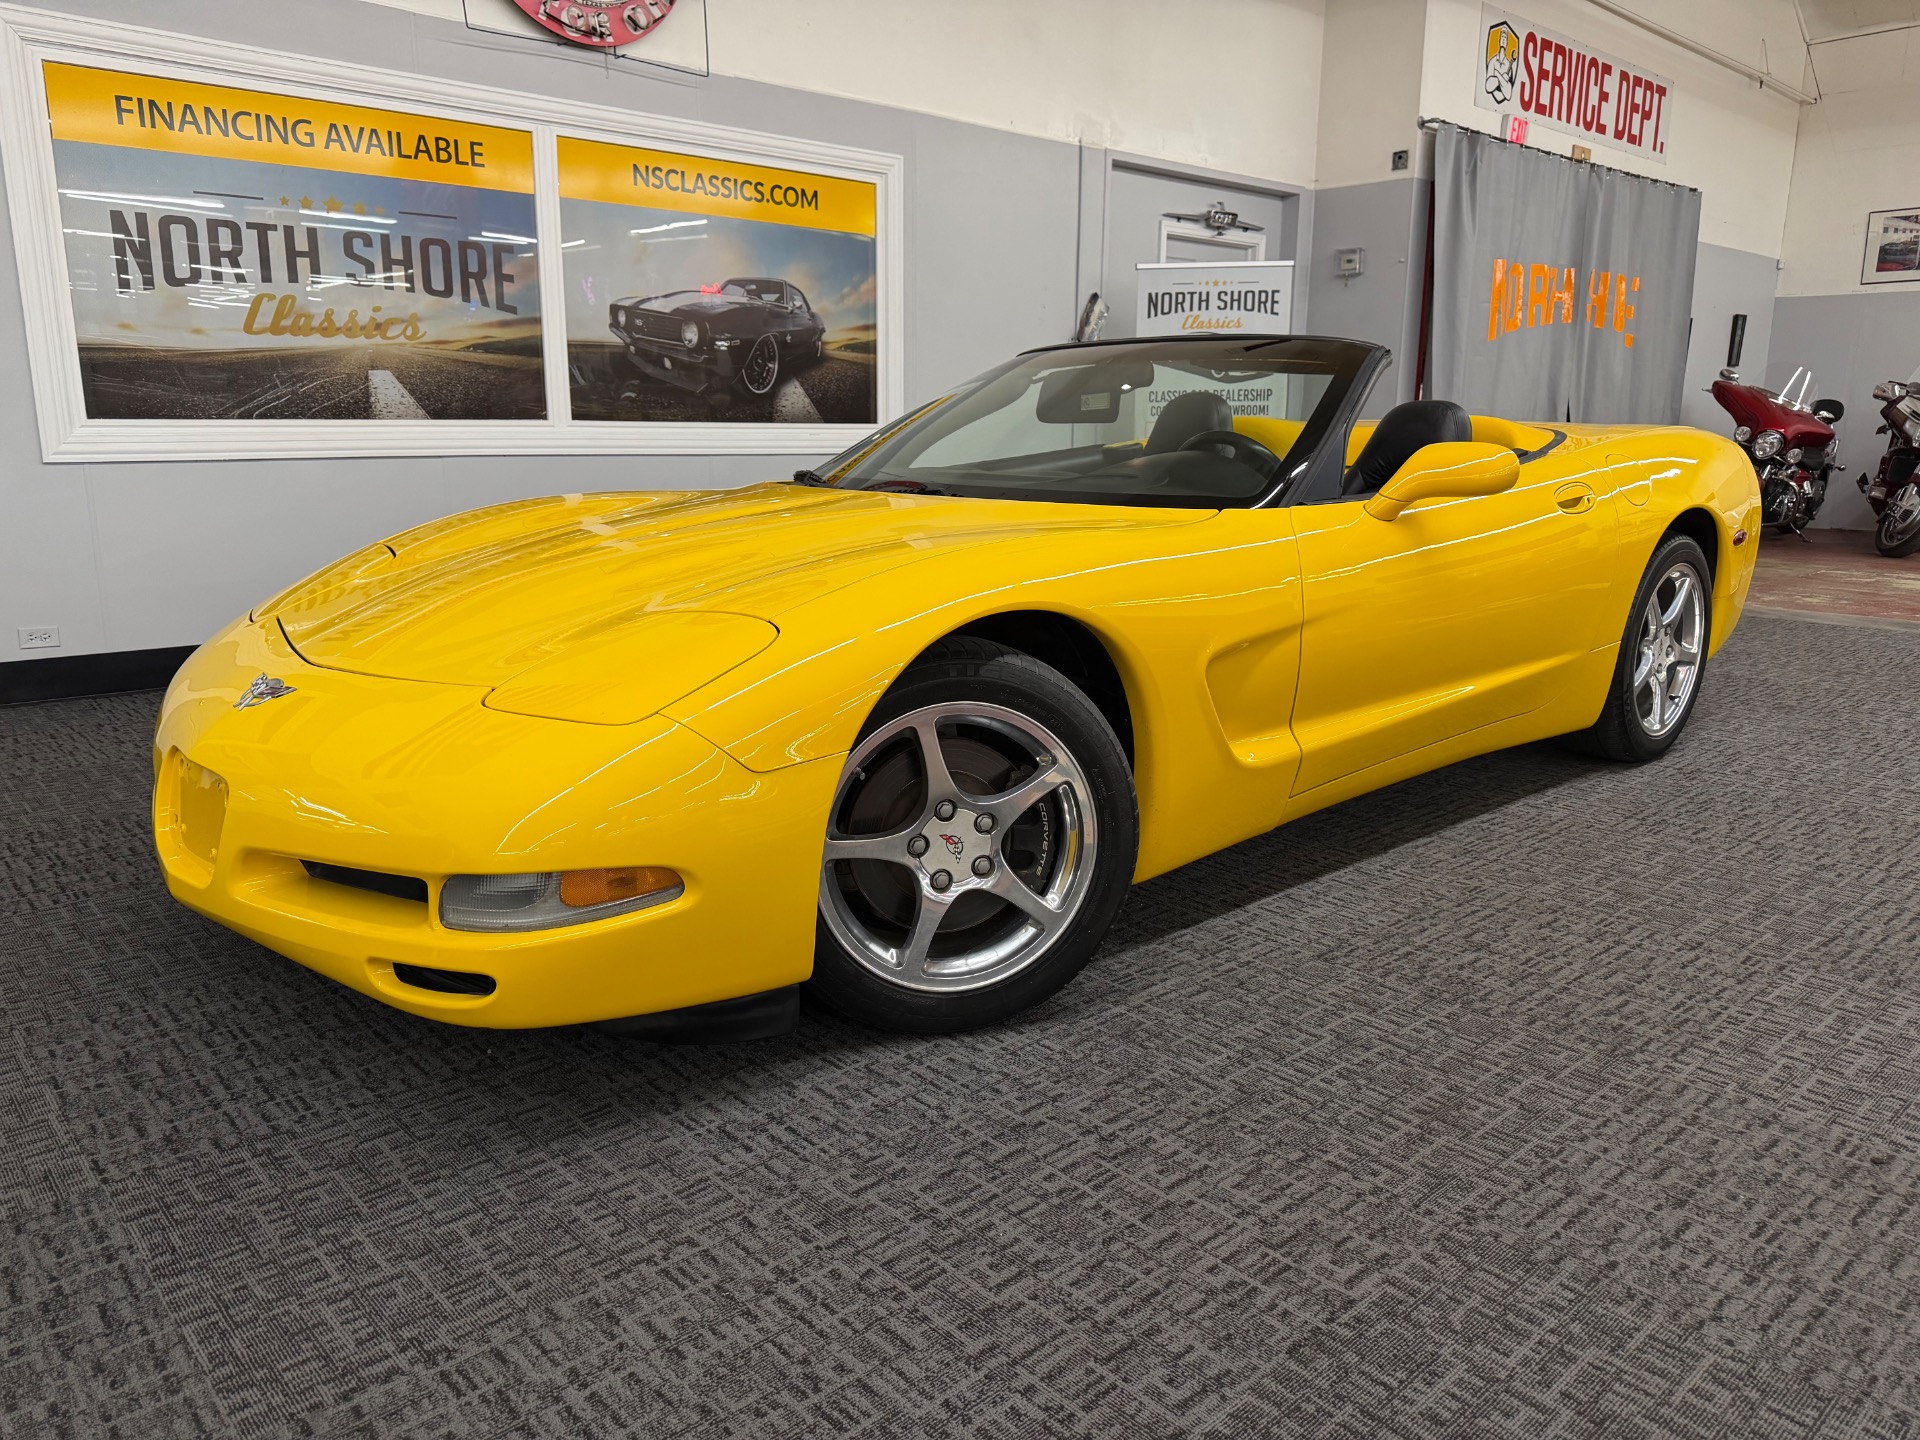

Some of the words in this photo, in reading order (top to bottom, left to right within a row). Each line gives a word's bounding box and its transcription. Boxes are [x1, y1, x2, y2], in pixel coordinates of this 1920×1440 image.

[1519, 31, 1613, 136] SERVICE
[1613, 69, 1667, 154] DEPT.
[114, 94, 315, 148] FINANCING
[324, 122, 486, 168] AVAILABLE
[1510, 116, 1528, 145] EXIT
[632, 163, 819, 211] NSCLASSICS.COM
[109, 209, 322, 295] NORTH
[342, 229, 518, 316] SHORE
[242, 292, 427, 342] Classics
[1147, 290, 1210, 319] NORTH
[1217, 289, 1280, 316] SHORE
[1181, 314, 1243, 330] Classics
[1036, 802, 1049, 877] CORVETTE
